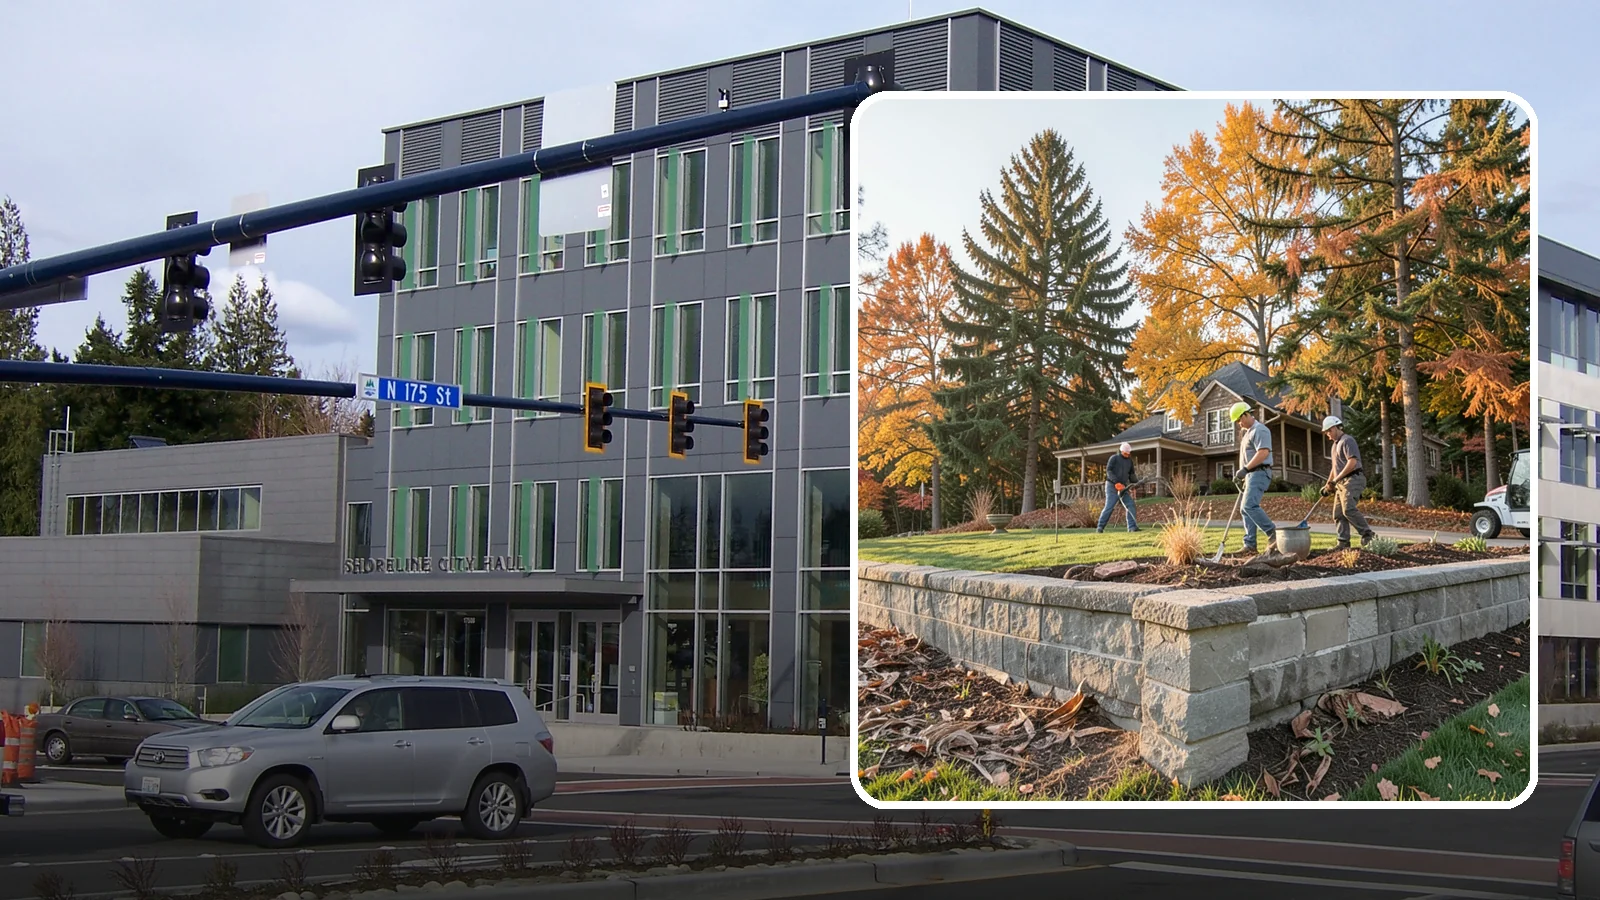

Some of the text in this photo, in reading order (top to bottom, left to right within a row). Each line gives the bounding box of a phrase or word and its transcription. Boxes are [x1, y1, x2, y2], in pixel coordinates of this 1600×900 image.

[387, 380, 451, 406] N 175 St
[344, 555, 525, 574] SHORELINE CITY HALL
